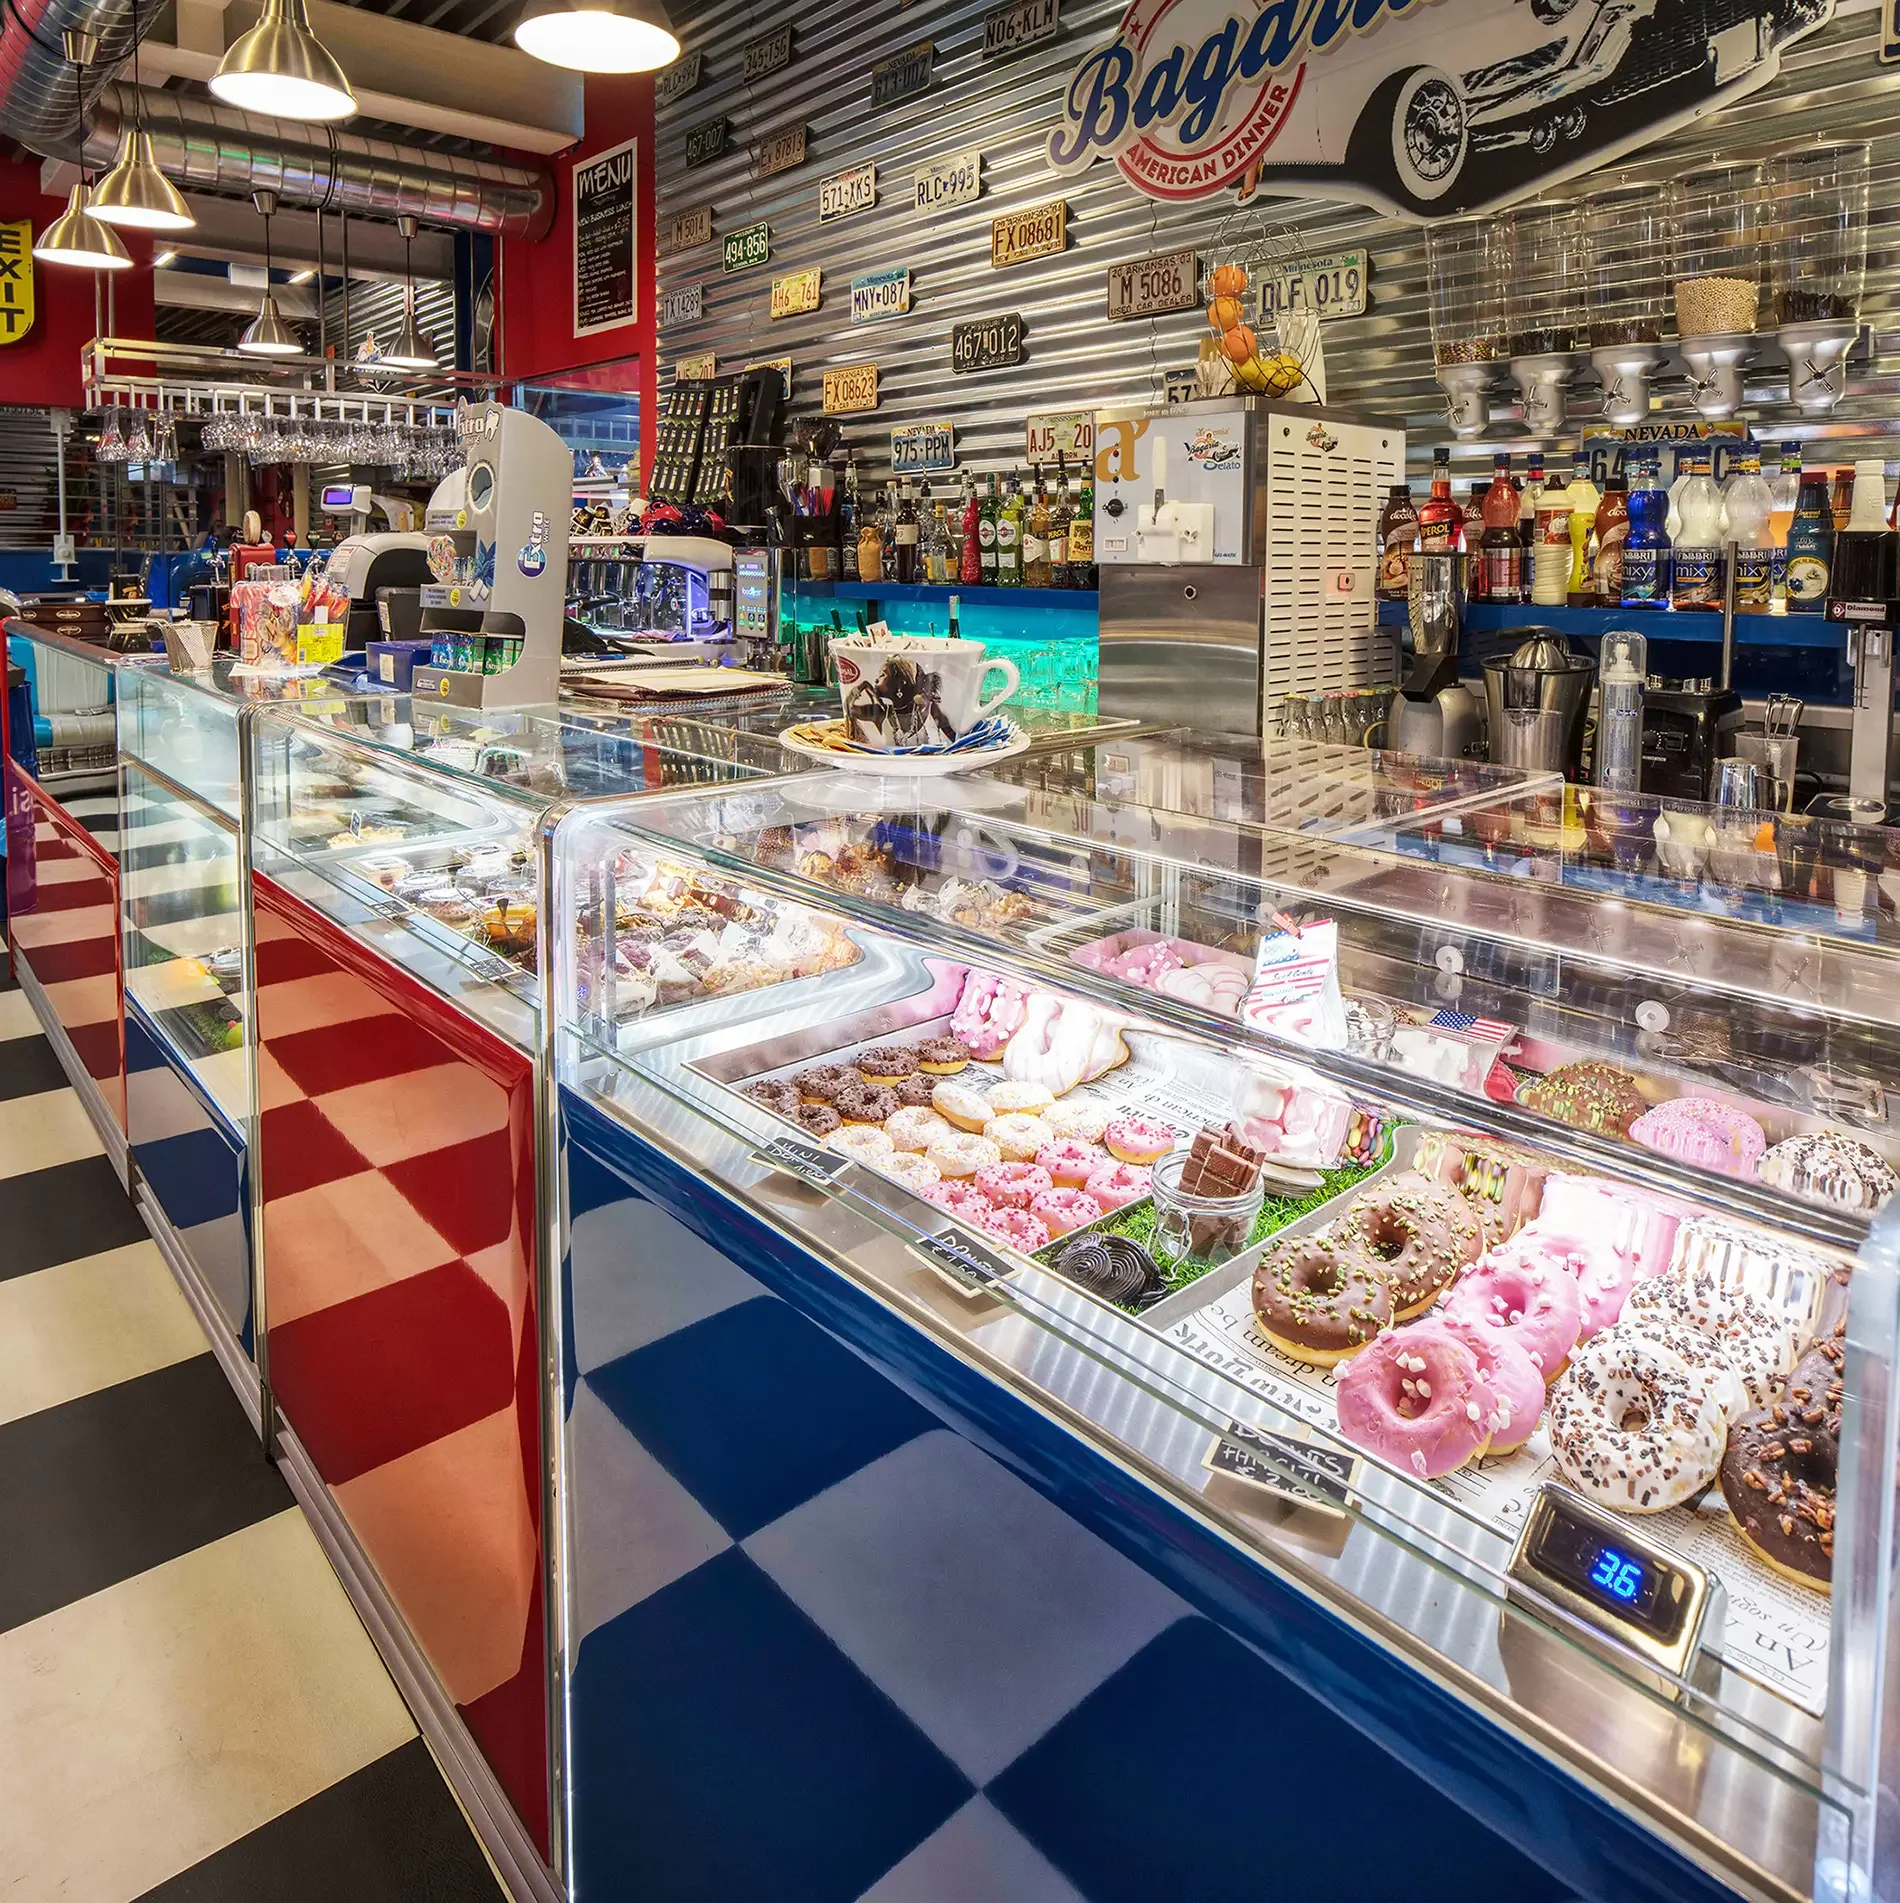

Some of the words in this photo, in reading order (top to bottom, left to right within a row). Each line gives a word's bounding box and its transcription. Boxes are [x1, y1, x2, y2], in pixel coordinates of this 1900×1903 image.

[1126, 143, 1217, 185] AMERICAN
[1222, 83, 1290, 170] DINNER
[579, 152, 632, 200] MENU
[823, 187, 843, 211] 571
[850, 175, 871, 204] XKS
[917, 175, 942, 206] RLC
[950, 163, 975, 195] 995
[0, 229, 25, 333] EXIT
[1125, 256, 1176, 276] ARKANSAS
[801, 280, 817, 303] 761
[853, 287, 876, 313] MNY
[882, 280, 905, 306] 087
[1120, 274, 1133, 305] M
[1140, 267, 1182, 301] 5086
[1317, 268, 1360, 305] 019
[1111, 304, 1132, 316] USED
[1136, 302, 1153, 311] CAR
[1158, 294, 1193, 307] DEALER
[954, 330, 982, 361] 467
[989, 324, 1018, 355] 012
[907, 424, 937, 438] NEVADA
[1030, 427, 1055, 453] AJ5
[1623, 423, 1701, 441] NEVADA
[1051, 452, 1078, 461] ALORN
[524, 510, 545, 570] Extra
[1676, 565, 1713, 583] mixy
[1846, 604, 1886, 613] Diamond
[1242, 1328, 1316, 1376] dream
[1591, 1550, 1643, 1599] 3.6
